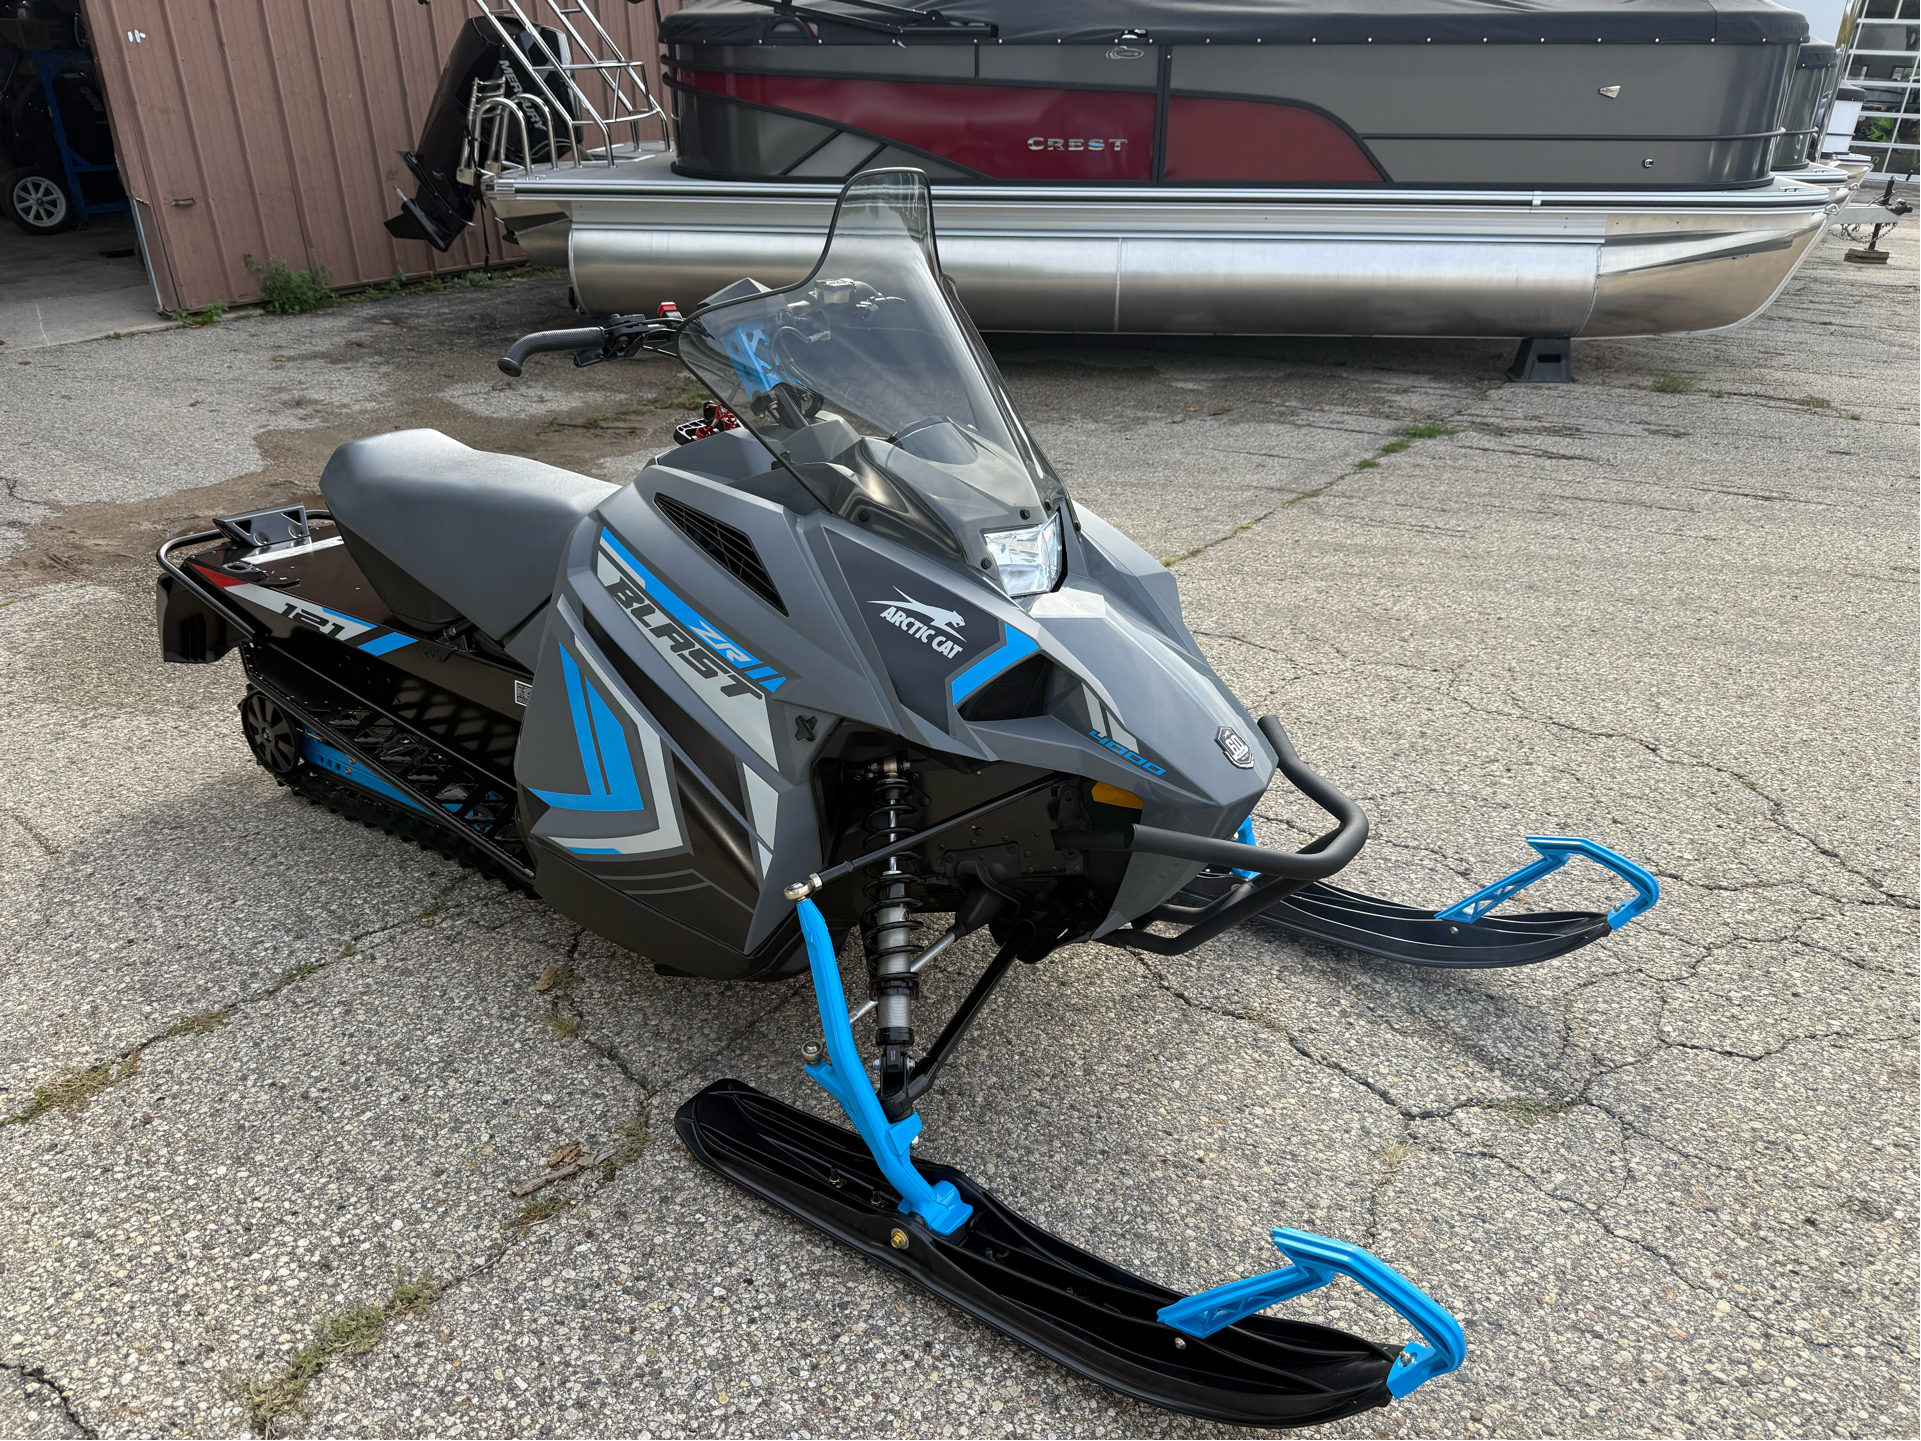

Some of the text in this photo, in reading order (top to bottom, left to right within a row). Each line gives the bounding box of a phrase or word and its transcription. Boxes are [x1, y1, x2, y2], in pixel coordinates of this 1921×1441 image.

[499, 60, 548, 131] MERURY
[1026, 137, 1128, 151] CREST
[280, 602, 345, 638] 121
[605, 576, 763, 700] BLAST
[689, 619, 752, 662] ZR
[880, 606, 964, 660] ARCTIC CAT
[1088, 730, 1166, 776] 4000
